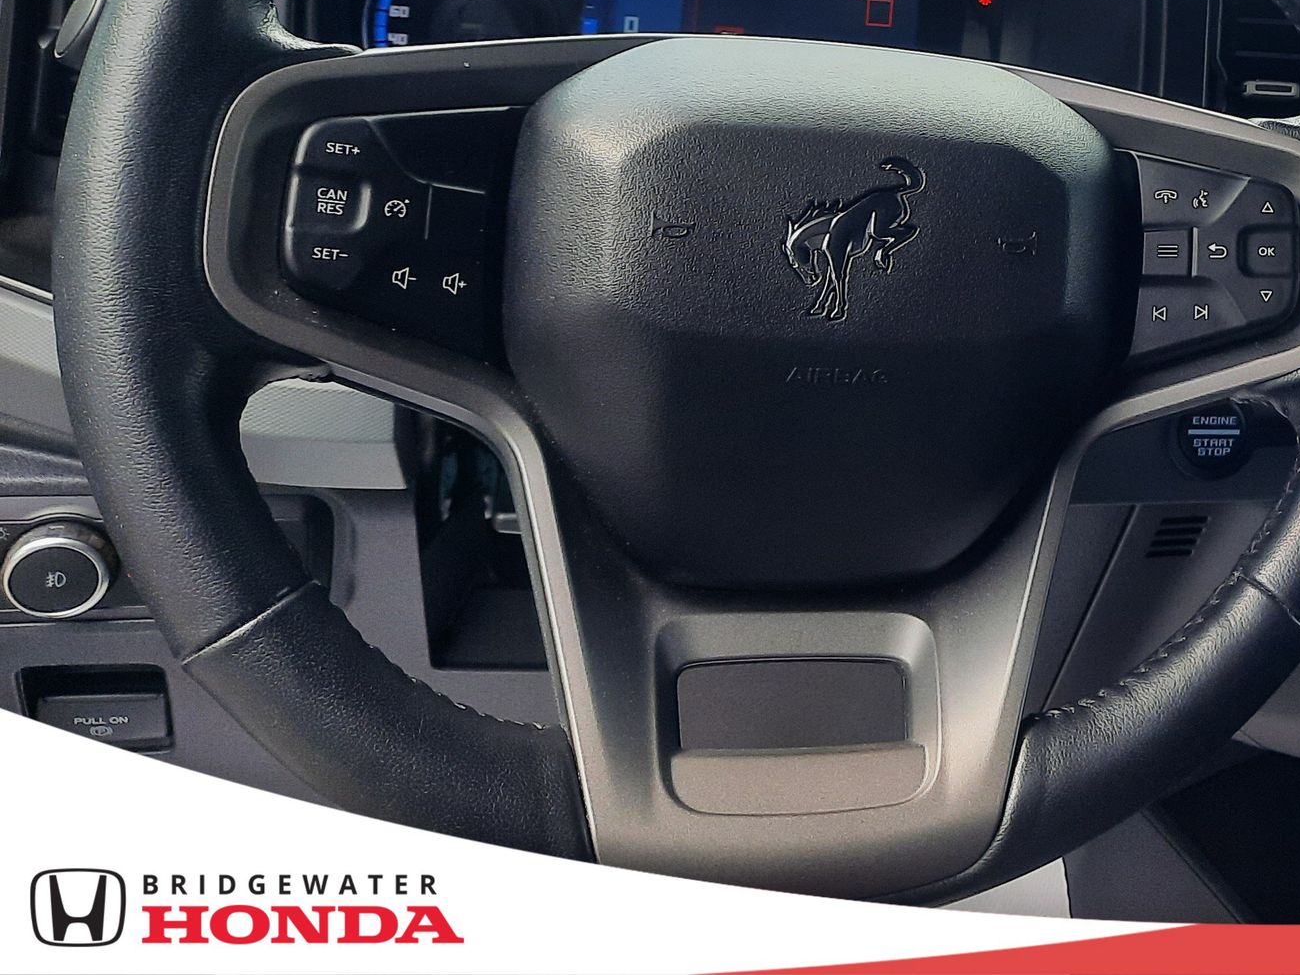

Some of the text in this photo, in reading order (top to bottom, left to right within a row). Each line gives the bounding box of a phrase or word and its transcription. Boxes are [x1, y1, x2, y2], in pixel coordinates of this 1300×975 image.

[325, 142, 361, 156] SET+
[317, 187, 348, 201] CAN
[317, 203, 344, 216] RES
[1258, 246, 1275, 257] OK
[785, 366, 889, 385] AIRBAG
[1192, 416, 1237, 426] ENGINE
[1193, 438, 1234, 448] START
[1197, 447, 1231, 457] STOP
[74, 715, 129, 725] PULL ON
